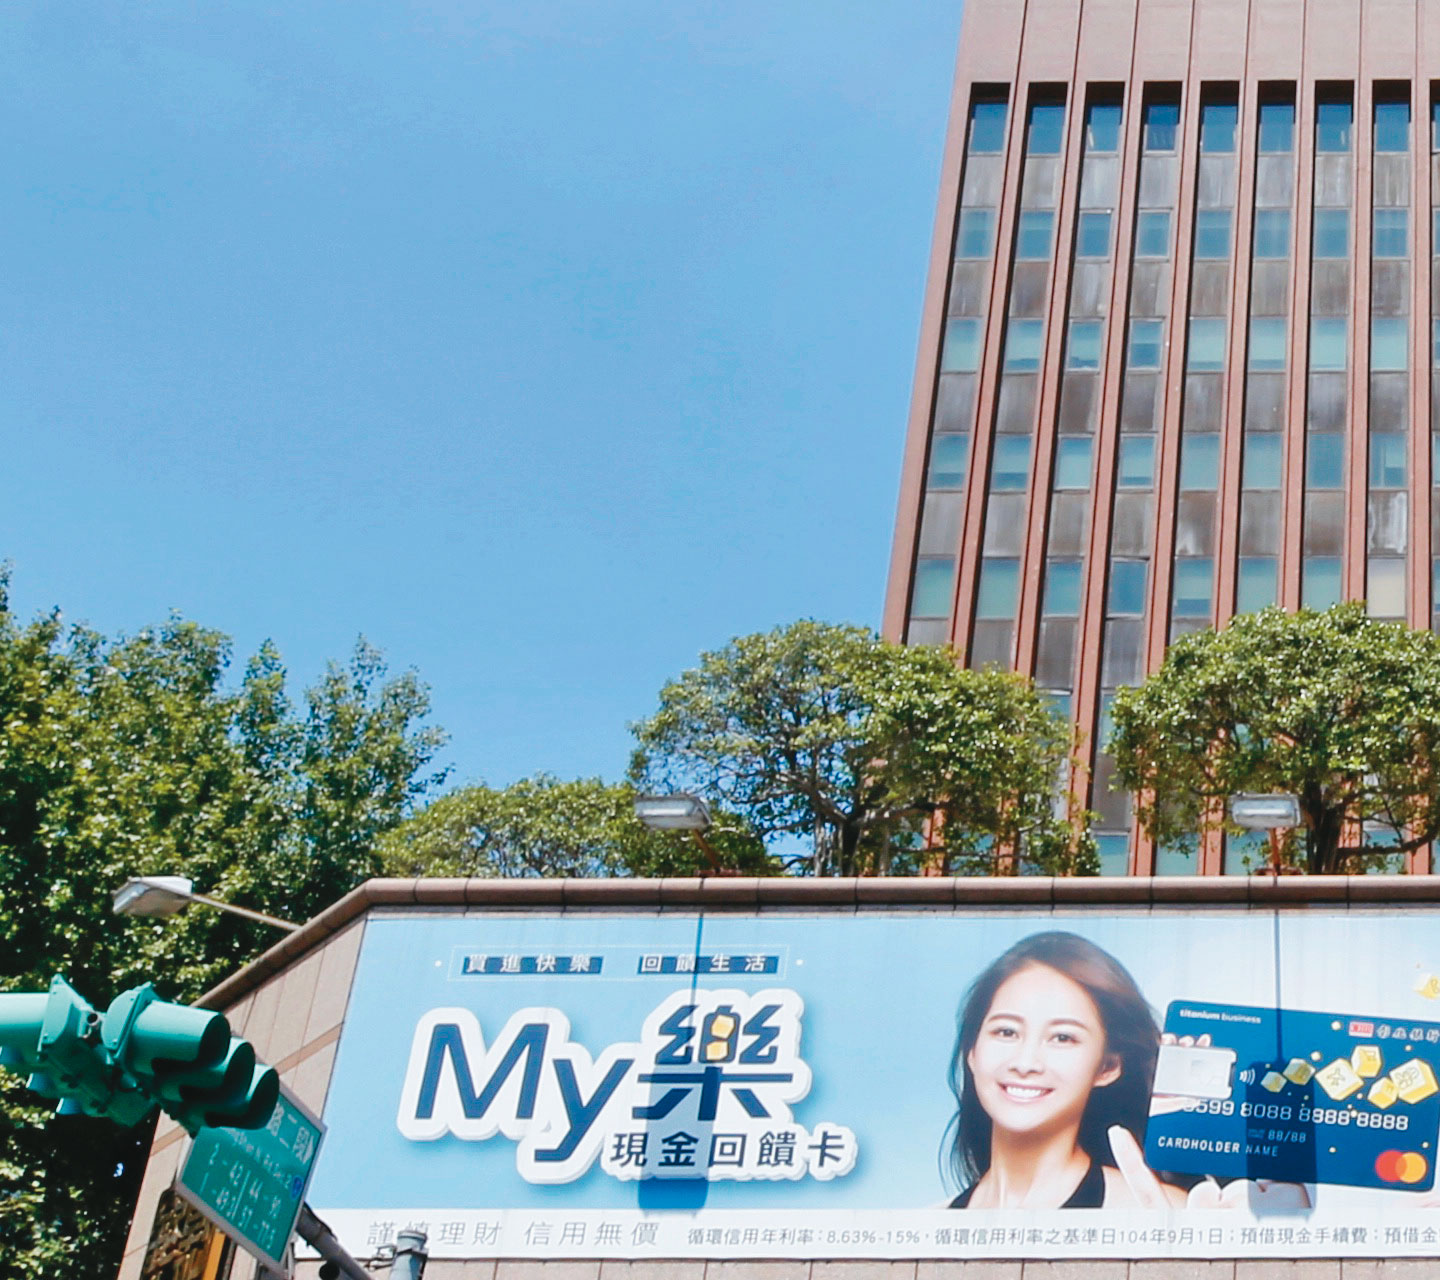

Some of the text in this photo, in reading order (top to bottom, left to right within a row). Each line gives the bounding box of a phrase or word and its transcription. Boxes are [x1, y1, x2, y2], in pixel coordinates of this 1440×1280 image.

[641, 954, 766, 973] 回饋生活
[1179, 1008, 1261, 1024] titanium business
[415, 1004, 794, 1163] My樂
[610, 1131, 845, 1168] 現金回饋卡
[1157, 1136, 1279, 1158] CARDHOLDER NAME
[524, 1220, 660, 1247] 信用無價
